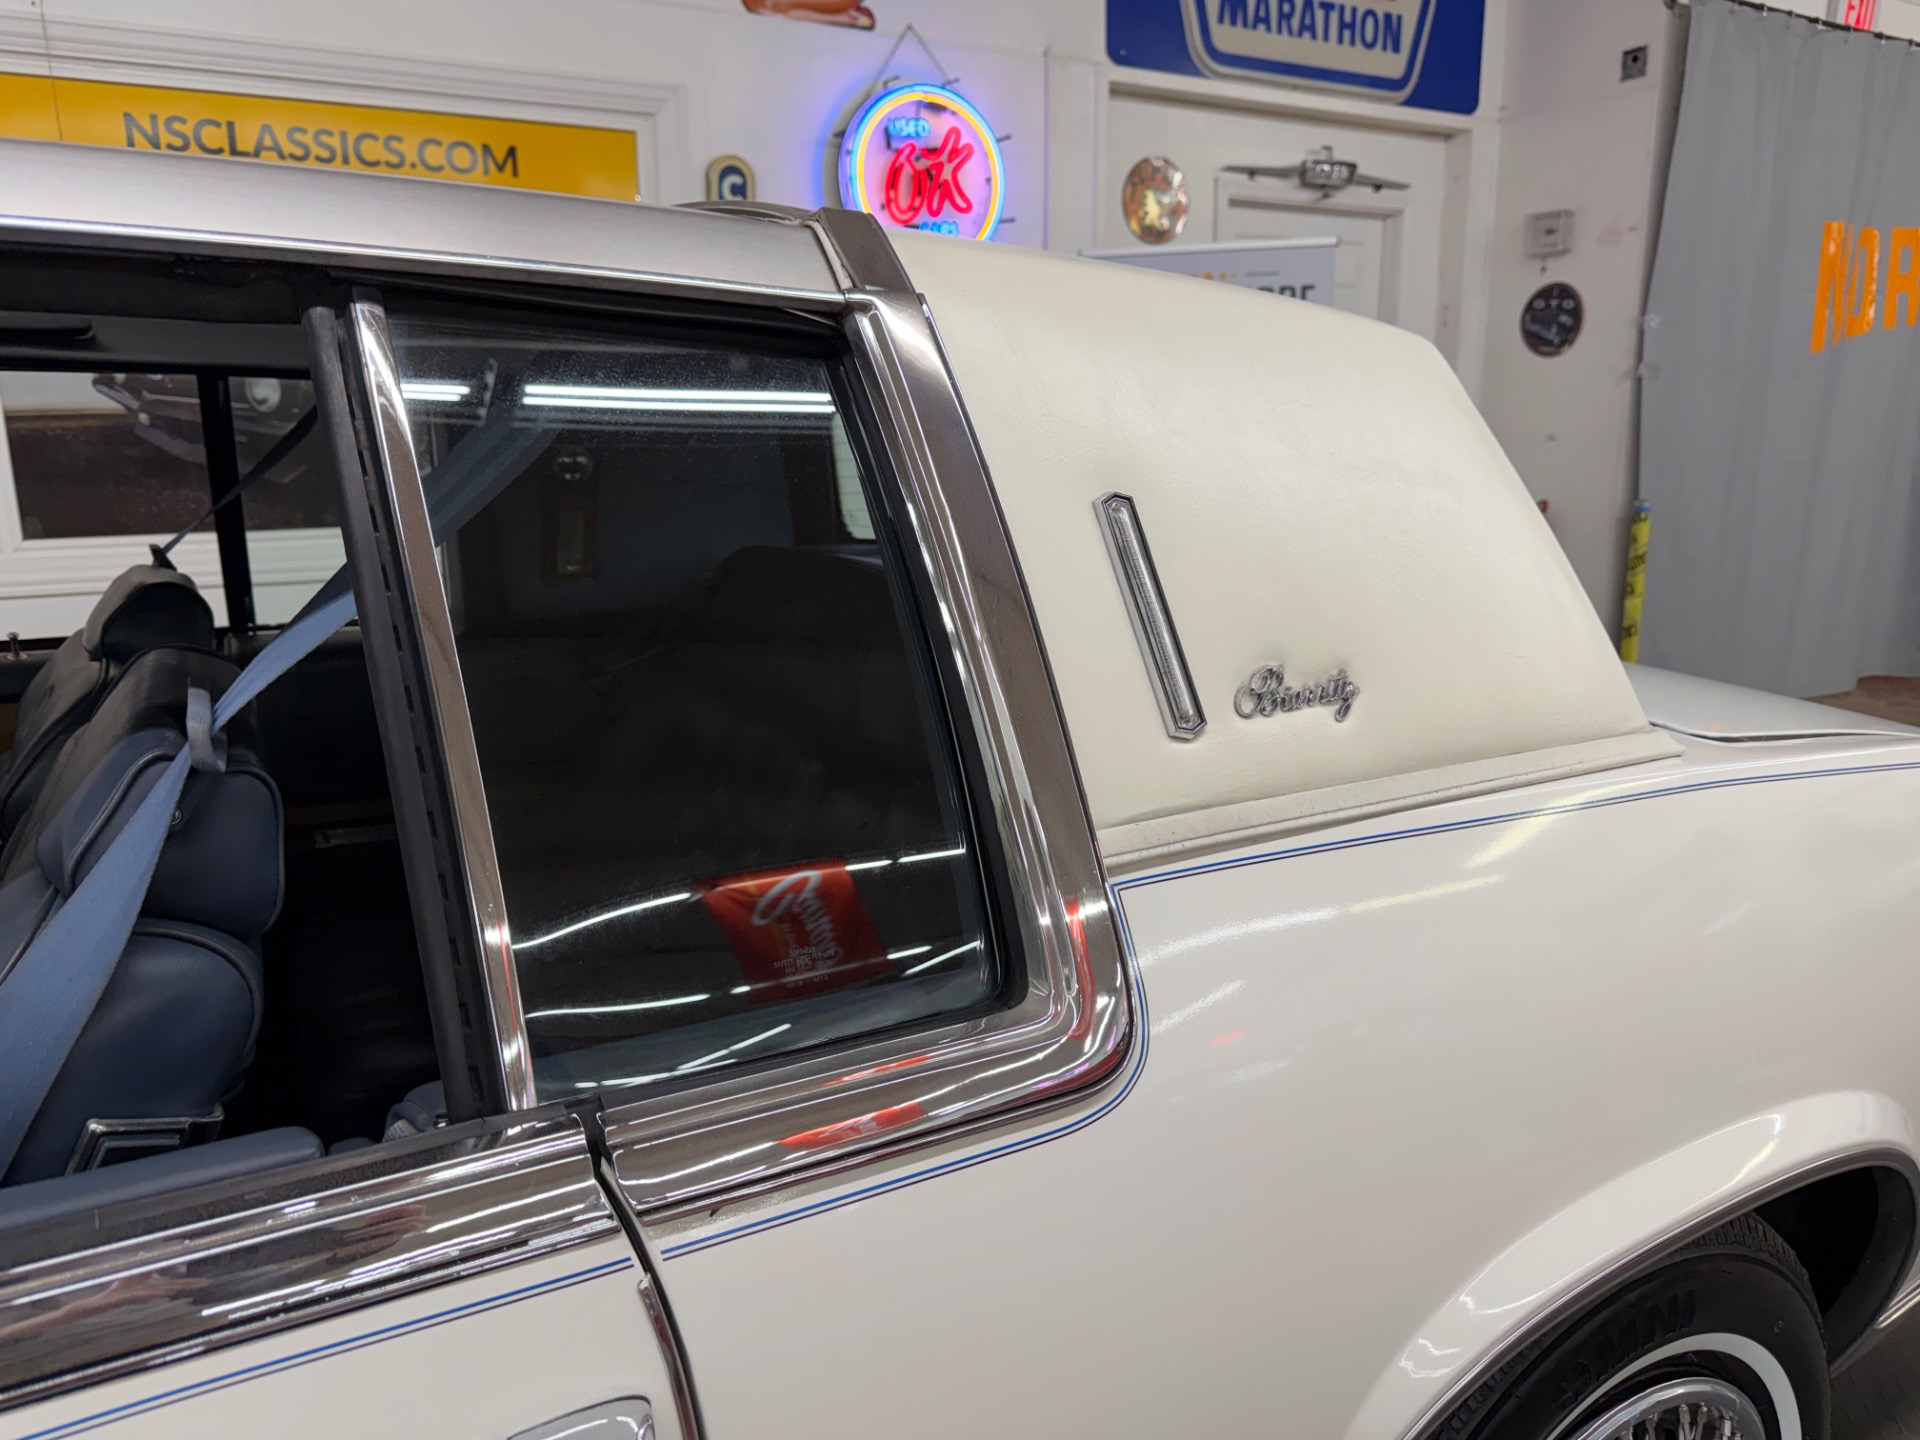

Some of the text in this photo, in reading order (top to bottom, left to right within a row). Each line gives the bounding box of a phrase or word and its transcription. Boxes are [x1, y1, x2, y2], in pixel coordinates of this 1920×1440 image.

[1217, 0, 1402, 54] MARATHON
[122, 111, 519, 178] NSCLASSICS.COM
[886, 117, 930, 138] USED
[885, 126, 974, 225] OK
